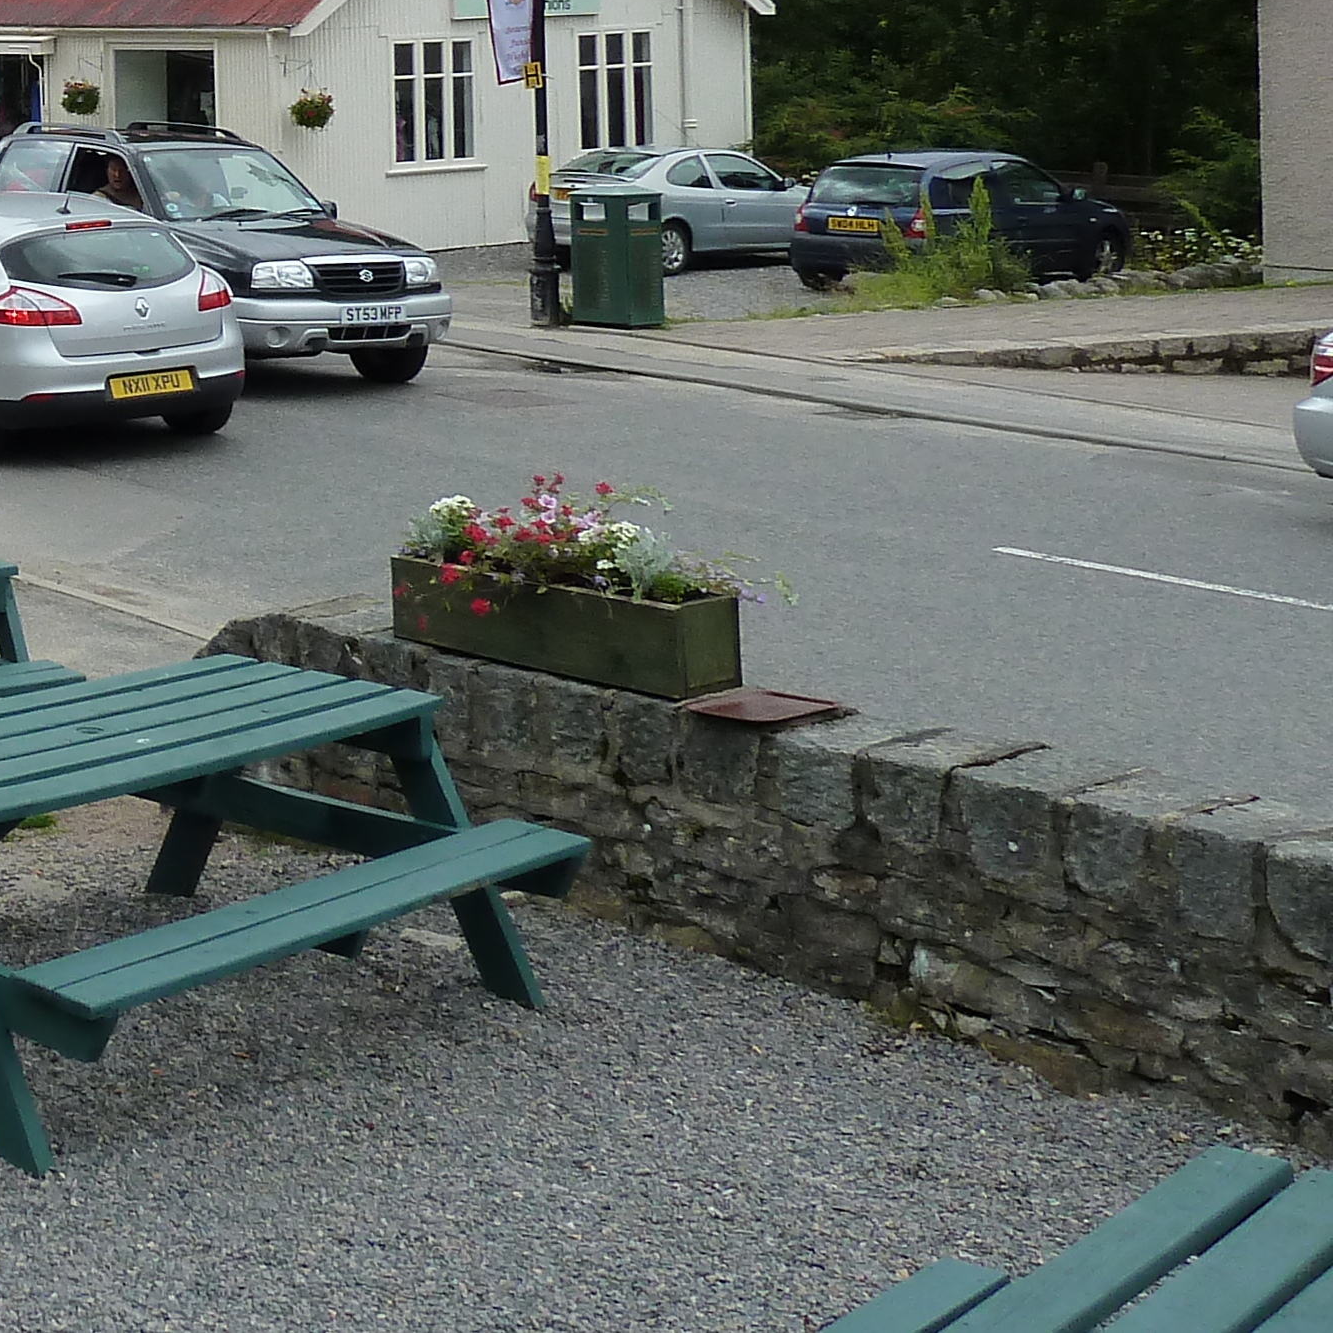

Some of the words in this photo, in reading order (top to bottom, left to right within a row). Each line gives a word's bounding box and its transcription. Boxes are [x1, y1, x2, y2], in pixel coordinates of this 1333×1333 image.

[524, 64, 541, 87] H
[346, 307, 378, 321] ST53
[151, 373, 180, 391] XPU
